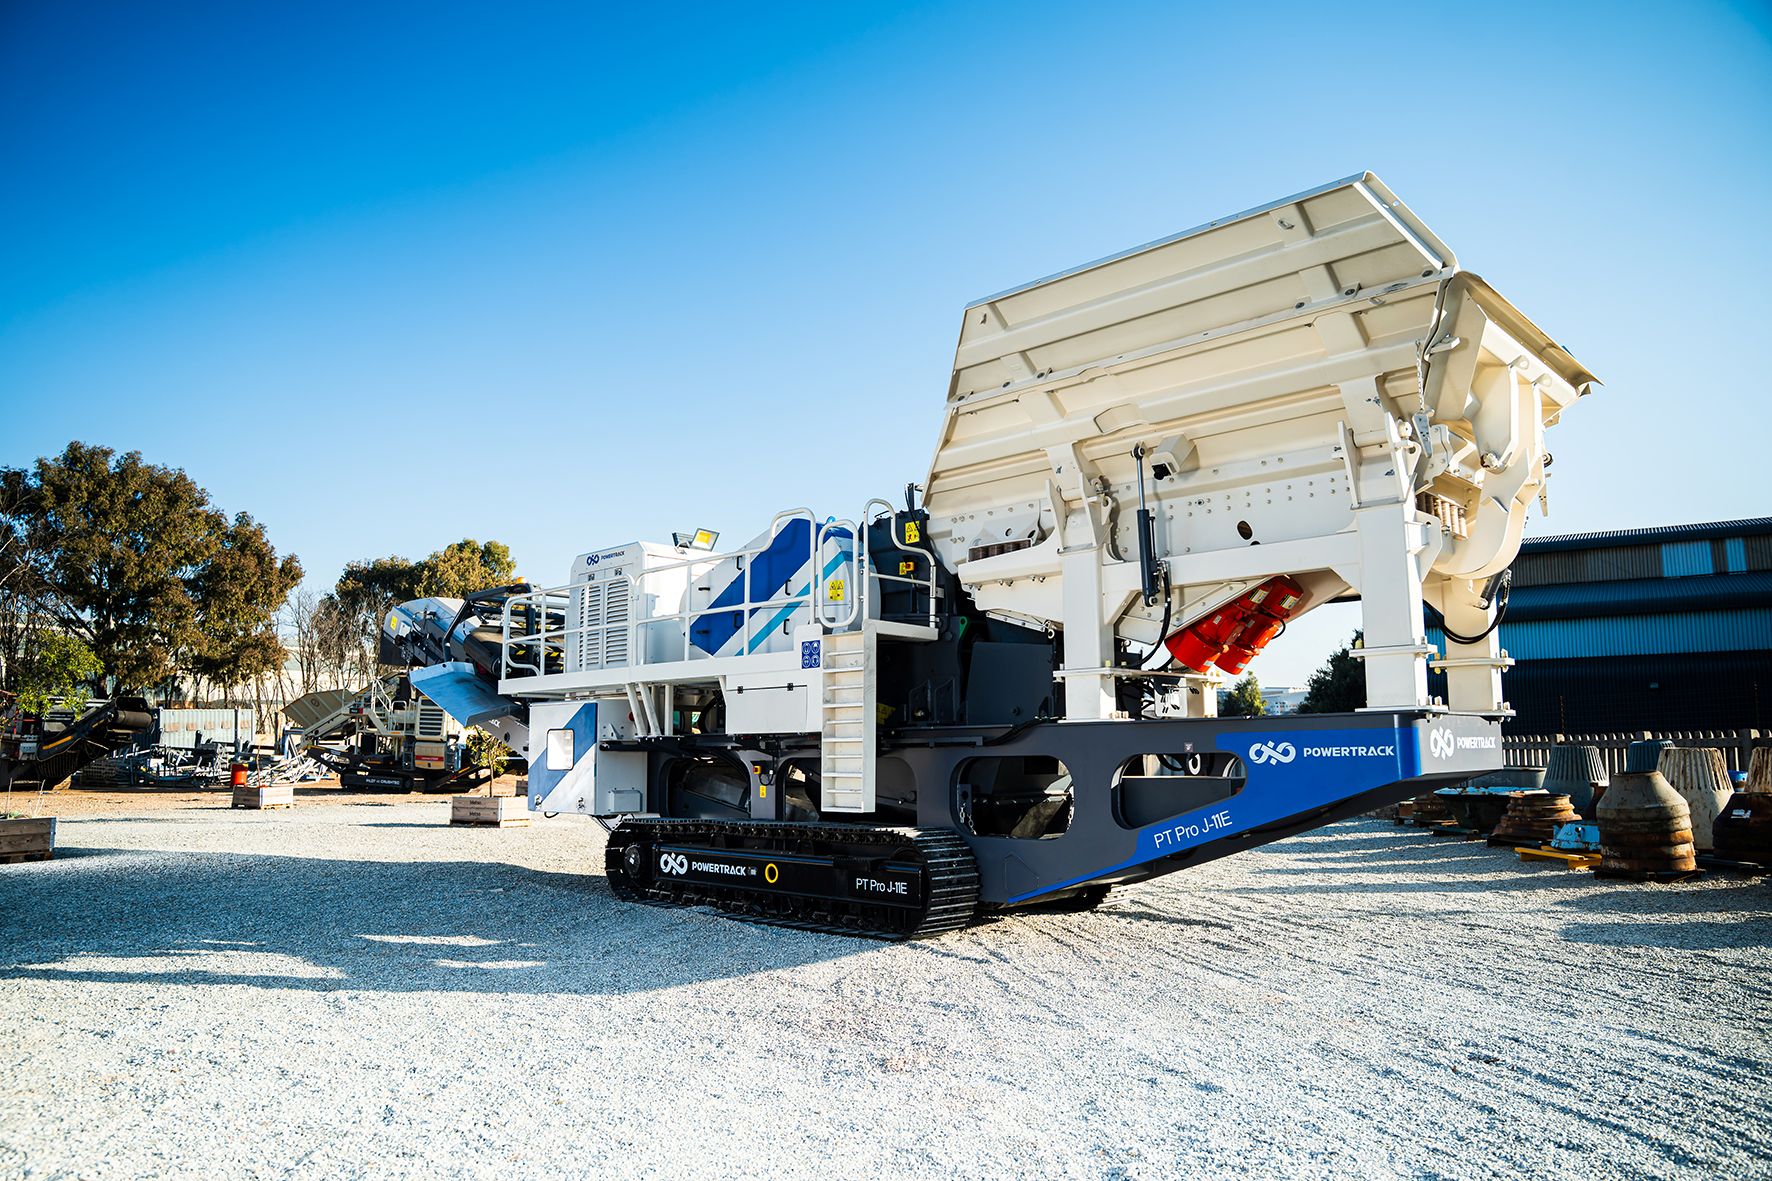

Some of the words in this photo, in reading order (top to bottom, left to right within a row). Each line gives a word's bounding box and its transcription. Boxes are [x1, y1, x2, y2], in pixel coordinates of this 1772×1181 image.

[601, 550, 625, 560] POWERTRACK
[1457, 736, 1496, 749] POWERTRACK
[1303, 745, 1395, 758] POWERTRACK
[1153, 829, 1172, 849] PT
[1174, 825, 1199, 842] Pro
[1202, 810, 1233, 833] J-11E
[691, 861, 747, 876] POWERTRACK
[856, 877, 869, 890] PT
[870, 879, 886, 892] Pro
[887, 881, 908, 895] J-11E
